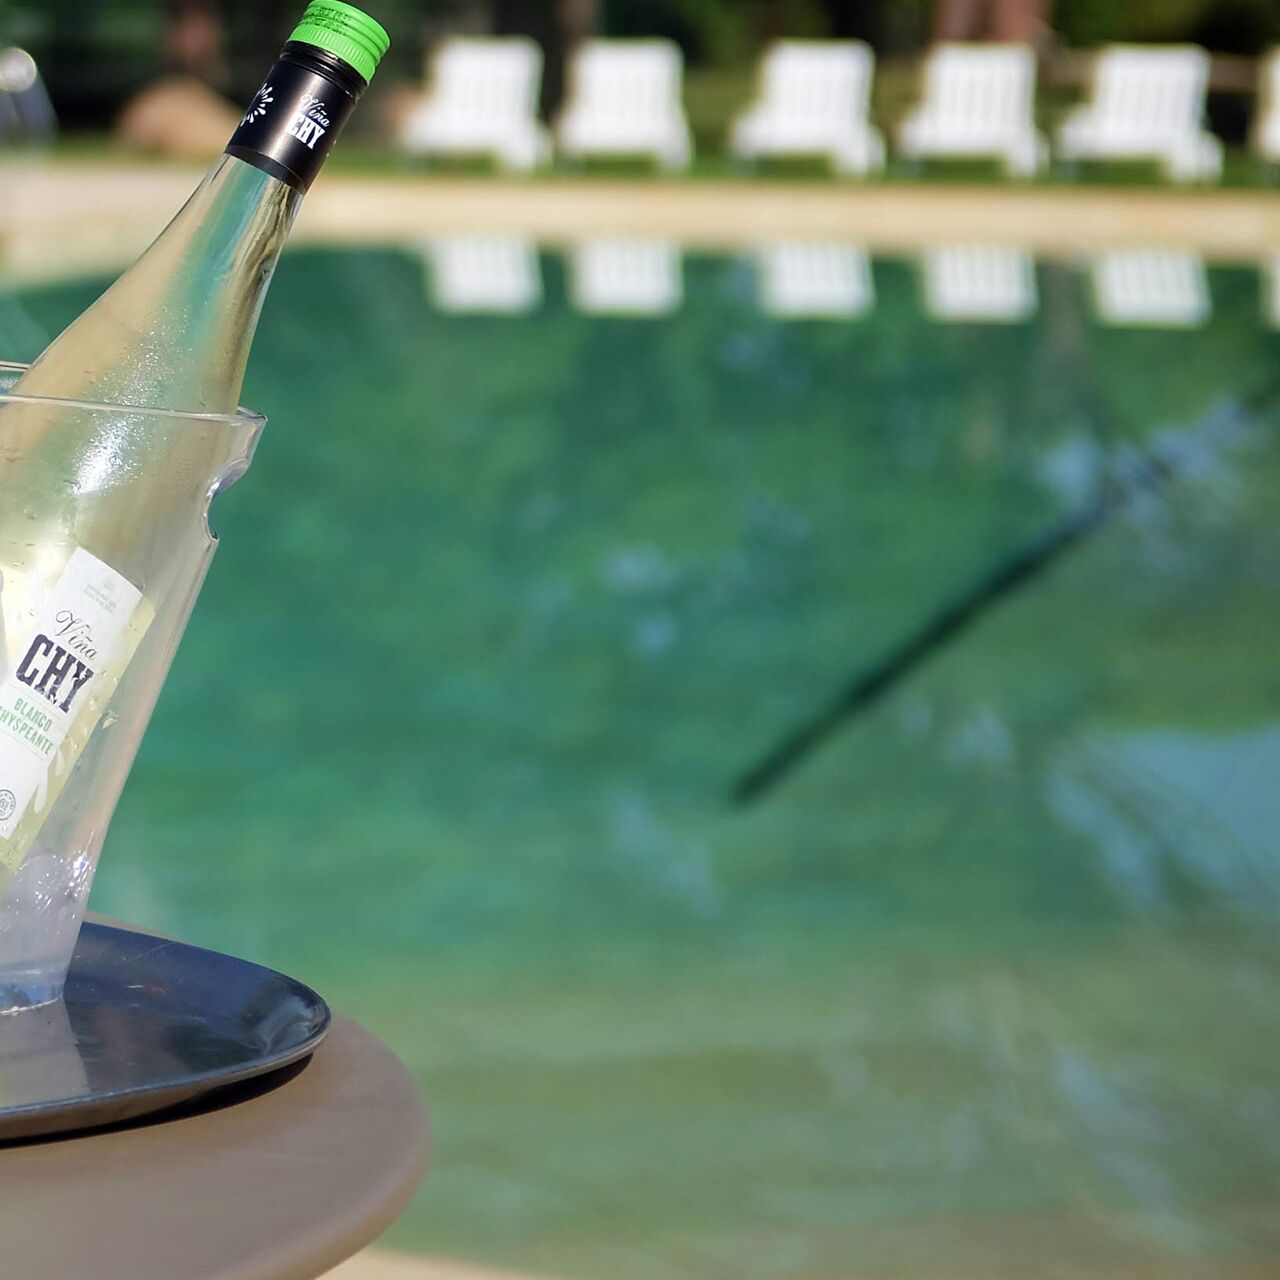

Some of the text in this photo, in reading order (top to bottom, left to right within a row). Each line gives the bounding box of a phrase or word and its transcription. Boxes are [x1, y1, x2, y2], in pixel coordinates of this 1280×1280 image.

[300, 94, 330, 128] Viña
[288, 113, 326, 149] CHY
[55, 609, 98, 661] Viña
[15, 633, 94, 714] CHY
[13, 696, 53, 732] BLANCO
